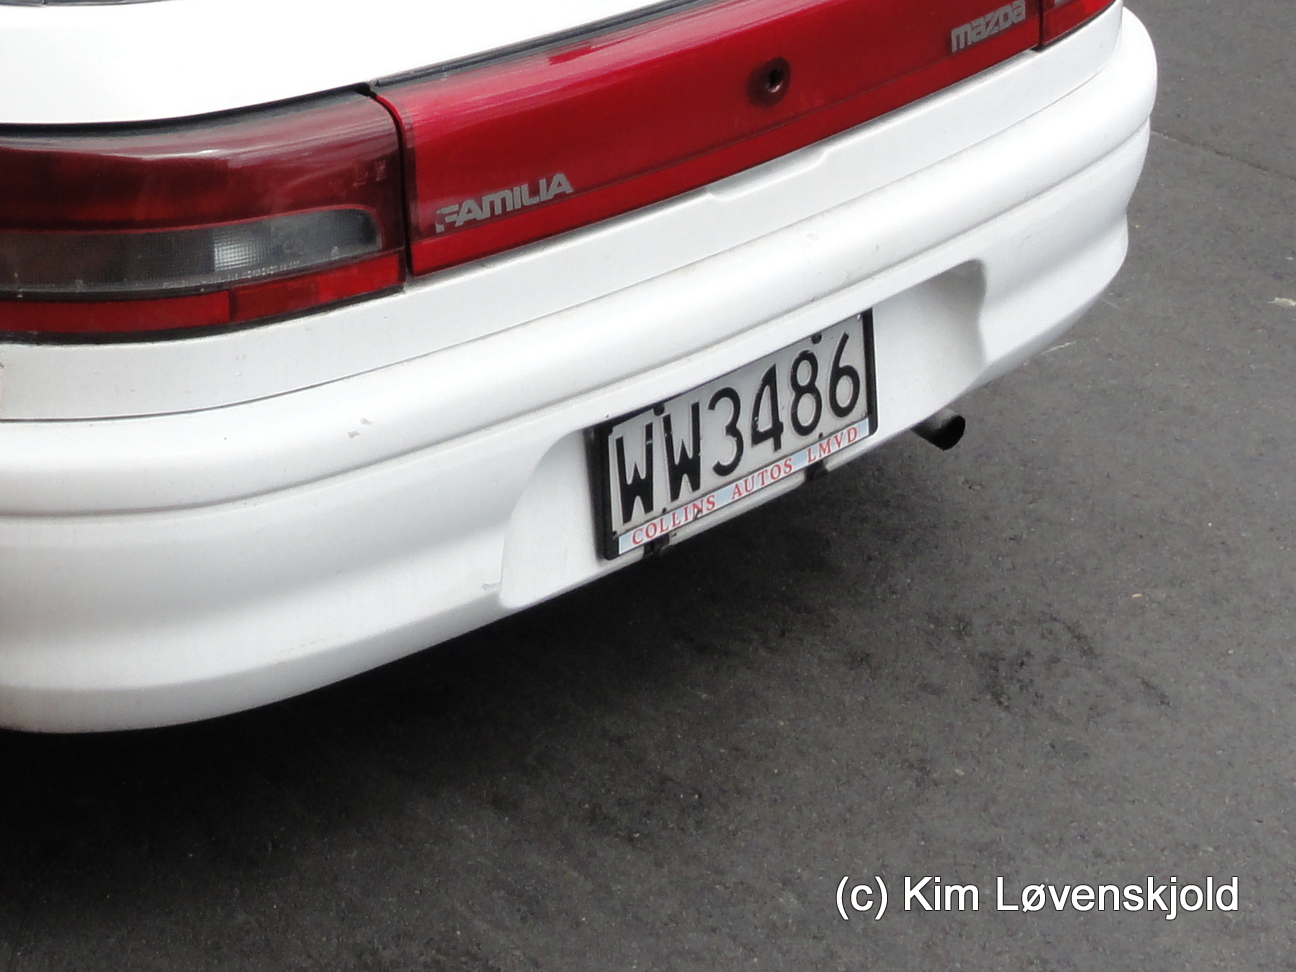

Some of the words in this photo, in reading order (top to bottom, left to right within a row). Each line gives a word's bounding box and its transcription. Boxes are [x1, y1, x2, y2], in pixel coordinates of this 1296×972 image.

[436, 173, 574, 234] FAMILIA
[615, 332, 861, 527] WW3486
[631, 494, 716, 545] COLLINS
[731, 457, 794, 500] AUTOS
[806, 426, 858, 464] LMVD
